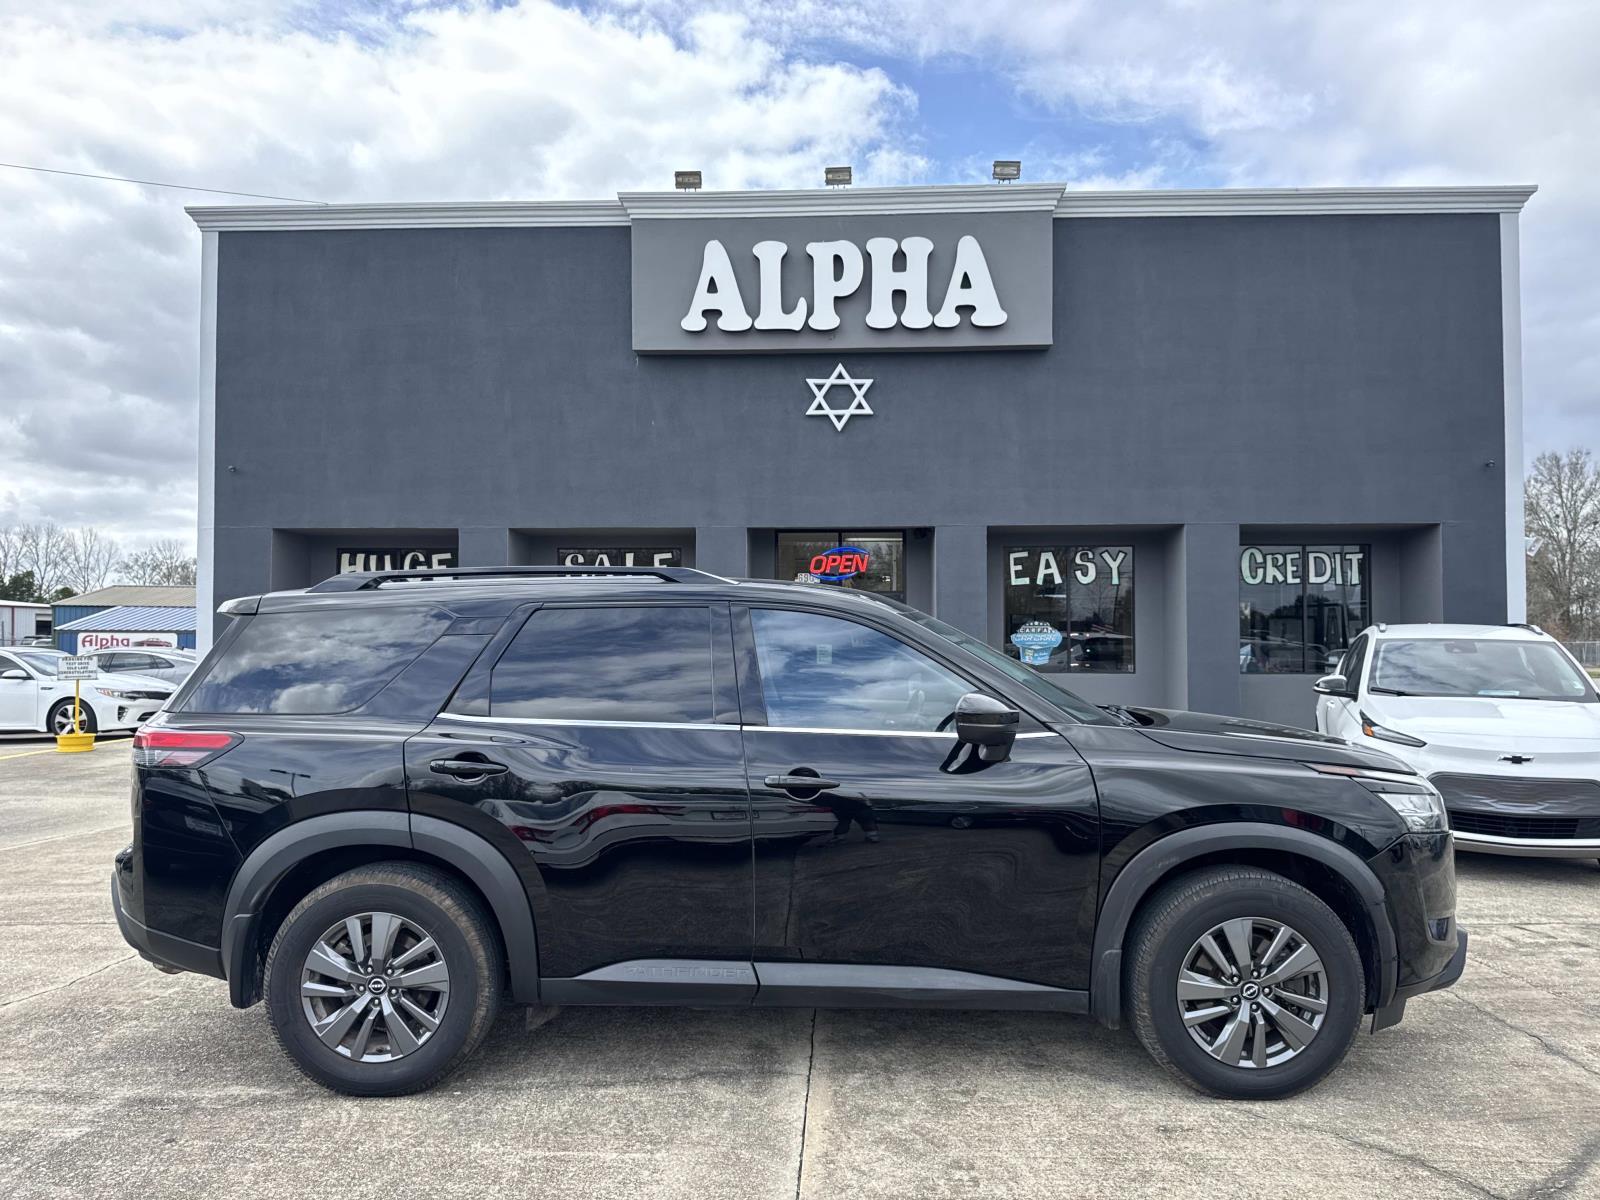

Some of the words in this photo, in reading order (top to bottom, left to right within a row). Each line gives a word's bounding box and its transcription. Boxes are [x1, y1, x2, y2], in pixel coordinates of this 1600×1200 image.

[680, 235, 1008, 332] ALPHA
[340, 551, 453, 582] HUGE
[809, 554, 870, 574] OPEN
[1009, 550, 1127, 586] EASY
[1240, 547, 1364, 586] CREDIT
[82, 634, 130, 648] Alpha
